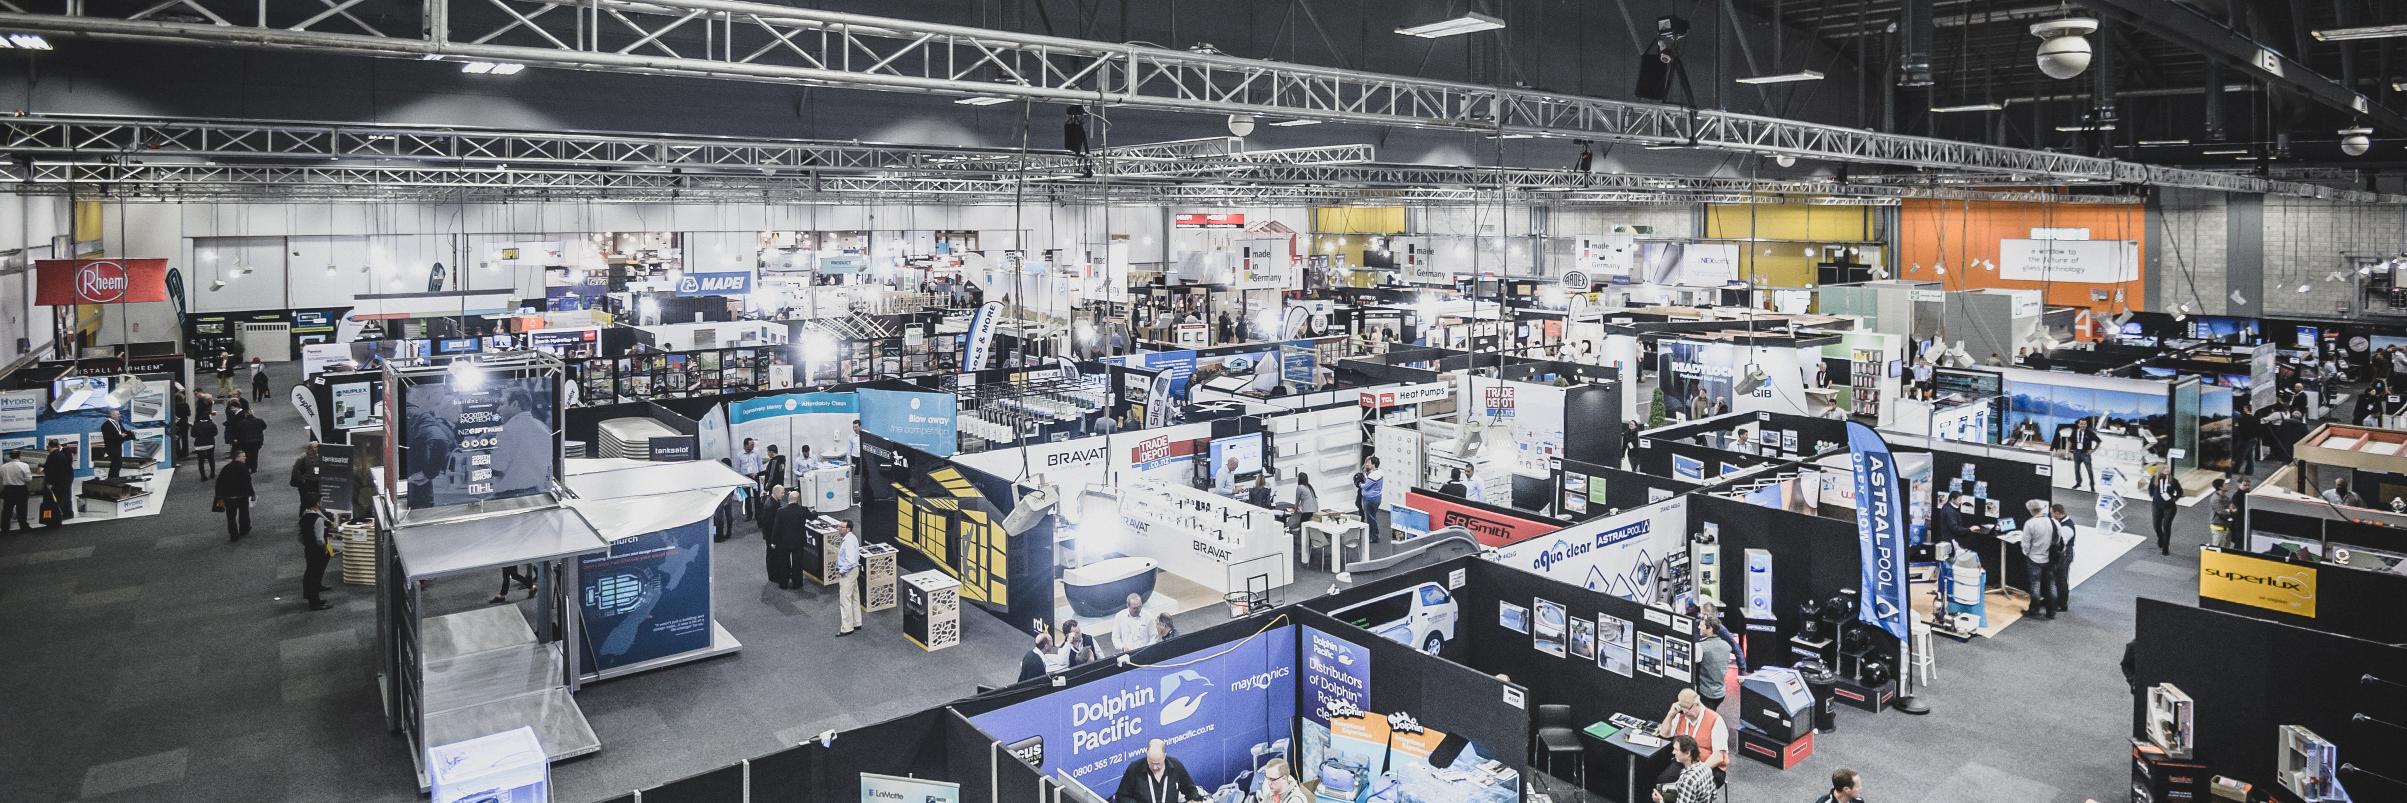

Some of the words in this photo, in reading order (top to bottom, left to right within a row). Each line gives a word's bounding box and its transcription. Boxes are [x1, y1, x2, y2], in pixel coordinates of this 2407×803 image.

[1416, 258, 1423, 266] in
[82, 263, 124, 296] Rheem
[1252, 274, 1282, 283] Germany
[1416, 268, 1446, 280] Germany
[1565, 275, 1587, 286] ARDEX
[700, 276, 744, 291] MAPEI
[982, 304, 996, 333] MORE
[1400, 391, 1418, 400] Heat
[1420, 387, 1445, 398] Pumps
[1486, 388, 1514, 398] TRADE
[1751, 389, 1772, 398] GIB
[1486, 398, 1514, 407] DEPOT
[908, 415, 927, 423] Blow
[928, 416, 950, 426] away
[1151, 399, 1160, 426] Silca
[1140, 437, 1168, 452] TRADE
[1047, 447, 1107, 466] BRAVAT
[1142, 447, 1169, 462] DEPOT
[1853, 452, 1866, 495] OPEN
[1121, 516, 1151, 532] RAVAT
[1469, 520, 1511, 539] Smith
[1859, 506, 1870, 543] NOW
[1869, 455, 1892, 591] ASTRALPOOL
[1597, 527, 1643, 547] ASTRALPOOL
[1193, 540, 1232, 561] BRAVAT
[1566, 541, 1592, 558] clear
[2205, 568, 2300, 592] superlux
[1313, 635, 1338, 652] Dolphin
[1313, 644, 1334, 660] Pacific
[1231, 665, 1289, 692] maytronics
[1309, 656, 1363, 690] Distributors
[1309, 674, 1319, 685] of
[1073, 685, 1155, 727] Dolphin
[1332, 707, 1365, 718] Dolphin
[1073, 716, 1143, 754] Pacific
[1393, 721, 1425, 734] Dolphin
[1073, 764, 1093, 778] 0800
[1094, 759, 1108, 771] 365
[1109, 753, 1123, 766] 722
